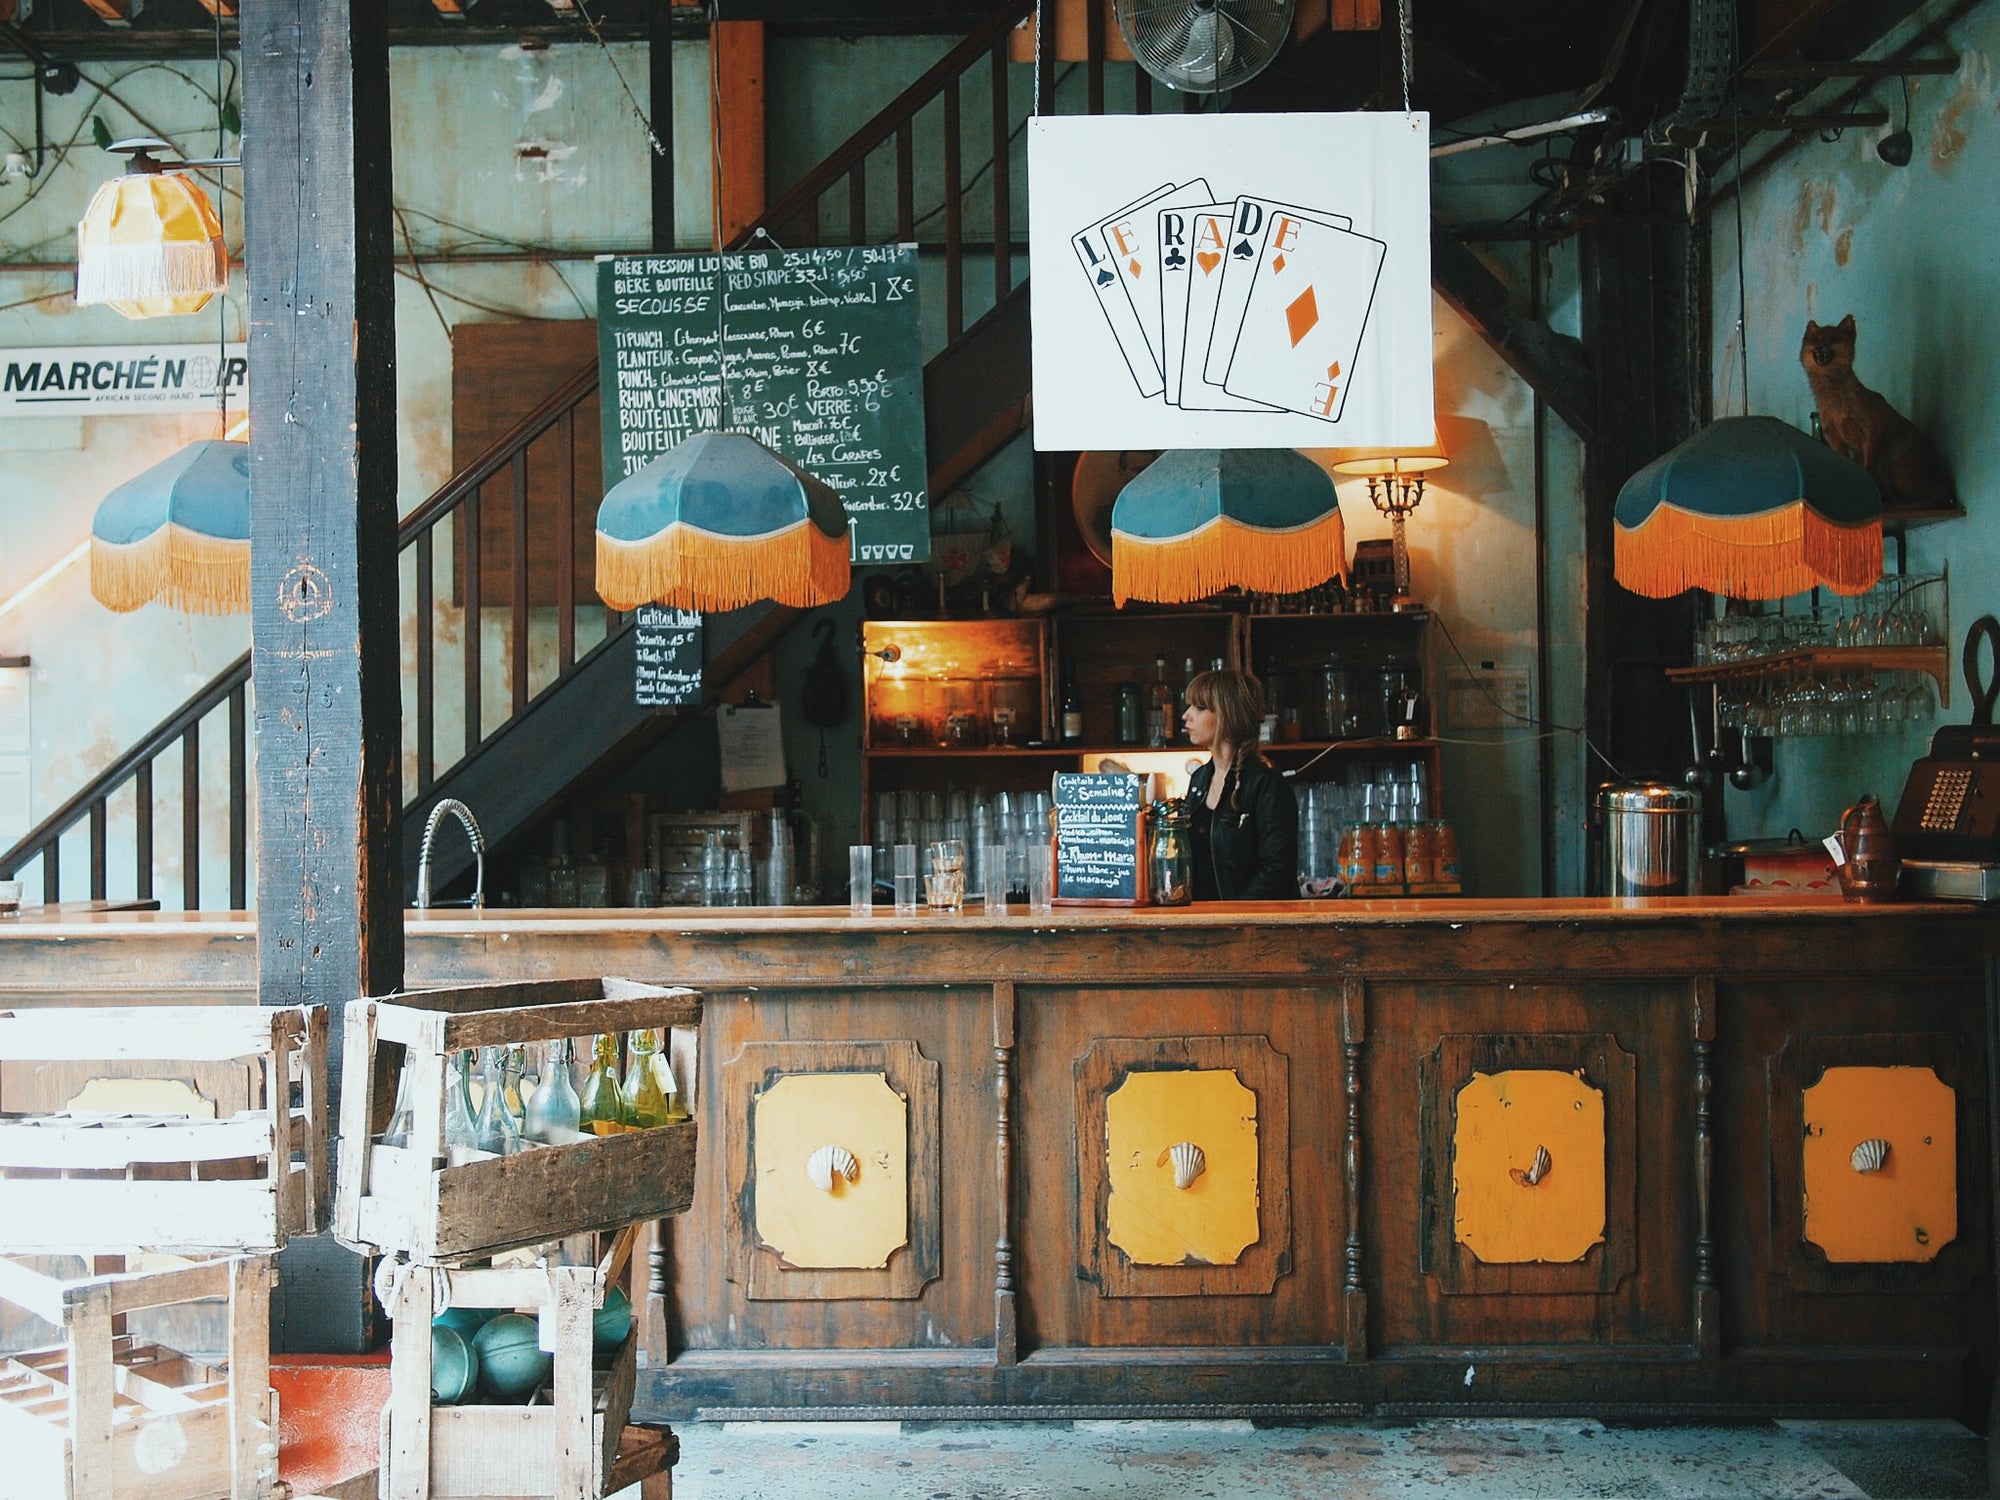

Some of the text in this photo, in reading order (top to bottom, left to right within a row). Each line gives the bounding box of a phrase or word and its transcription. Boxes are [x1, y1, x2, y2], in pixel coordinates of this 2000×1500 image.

[615, 257, 643, 275] BIÈRE
[646, 258, 695, 275] PRESSION
[749, 253, 769, 269] BIO
[614, 276, 651, 294] BIÈRE
[656, 276, 715, 293] BOUTEILLE
[3, 355, 159, 392] MARCHÉ
[619, 389, 656, 409] RHUM
[619, 408, 691, 429] BOUTEILLE
[695, 408, 719, 428] VIN
[1078, 786, 1126, 801] Semaine
